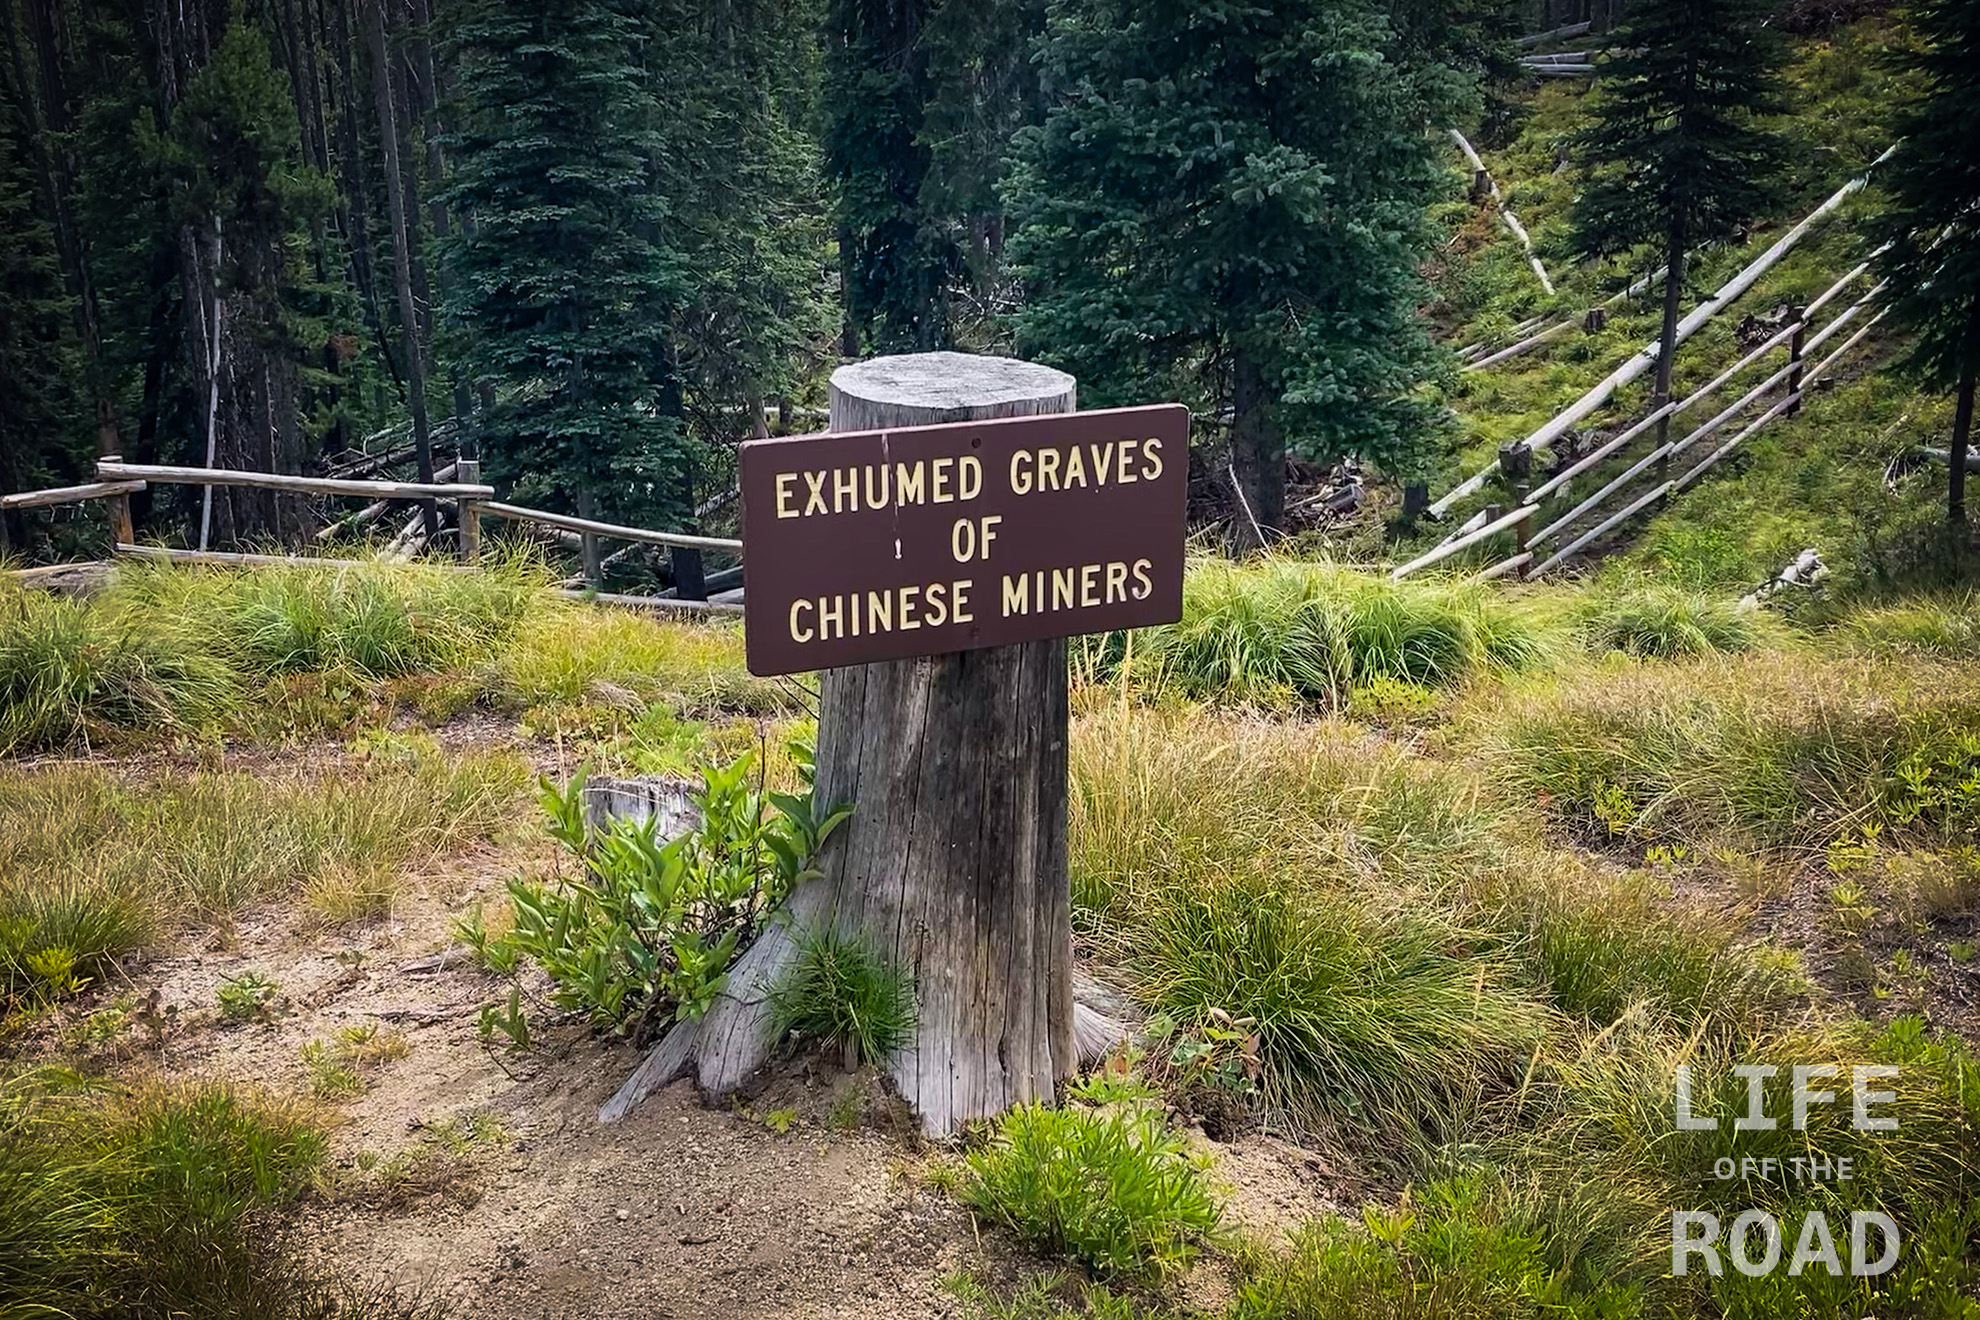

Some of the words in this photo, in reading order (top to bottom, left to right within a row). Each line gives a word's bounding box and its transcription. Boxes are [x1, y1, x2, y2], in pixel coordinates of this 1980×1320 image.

[775, 456, 983, 520] EXHUMED
[1009, 437, 1164, 496] GRAVES
[951, 515, 1003, 563] OF
[789, 579, 974, 644] CHINESE
[1001, 557, 1154, 618] MINERS
